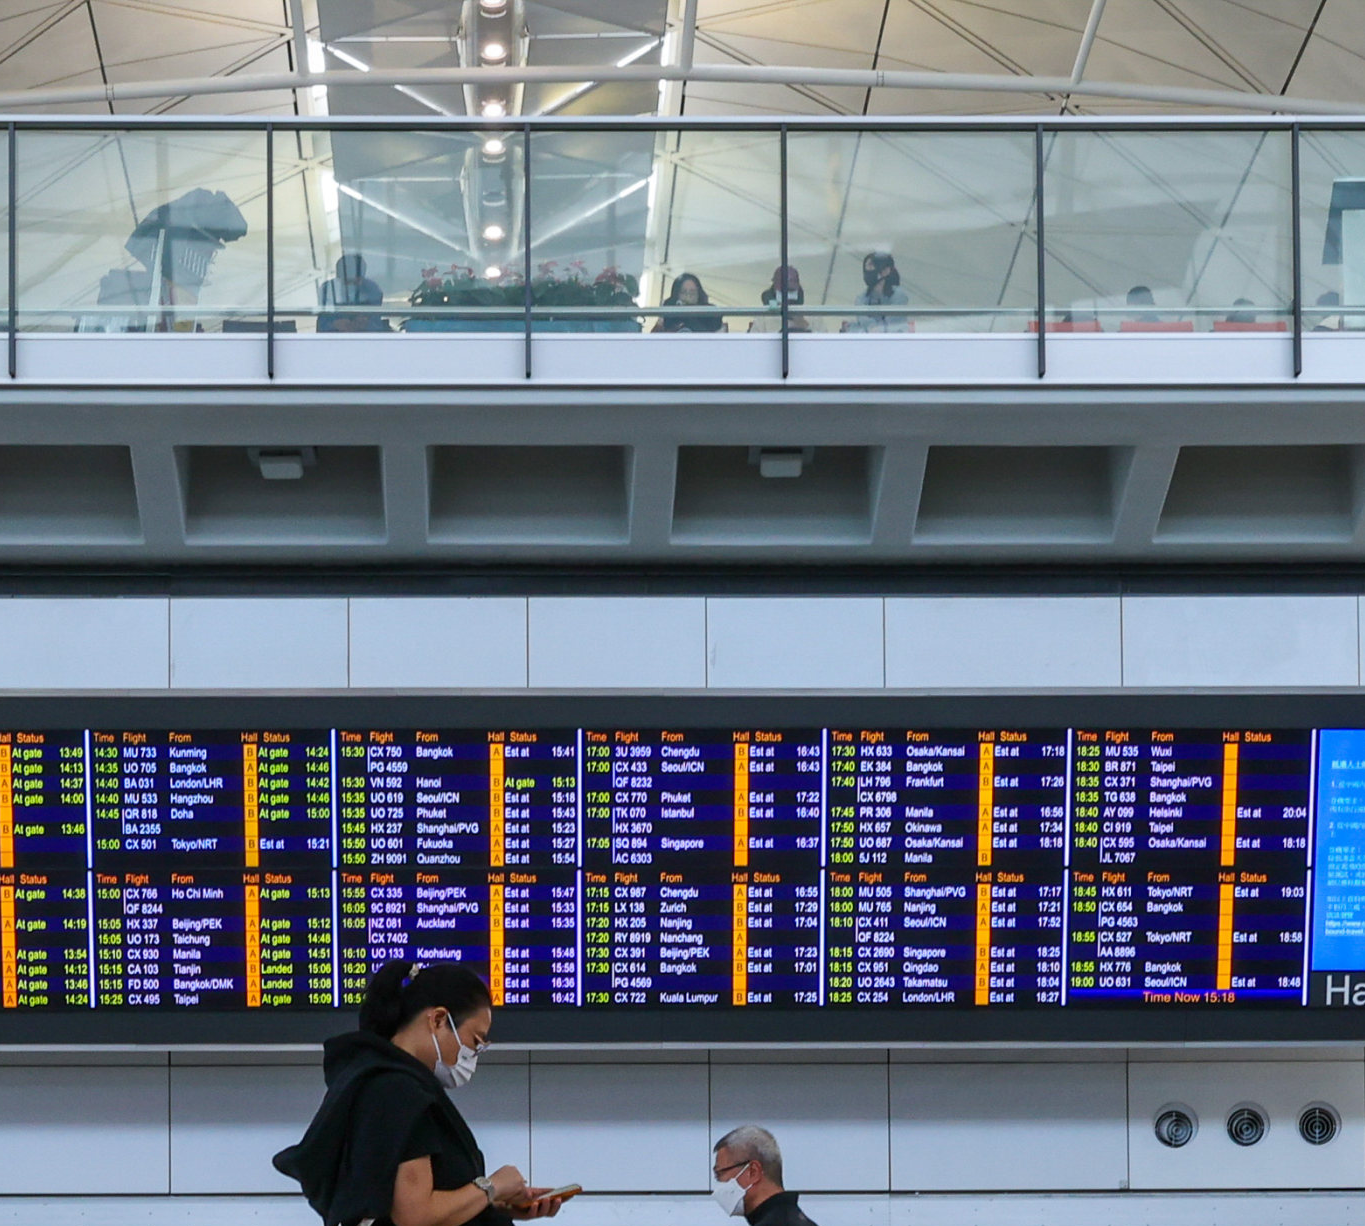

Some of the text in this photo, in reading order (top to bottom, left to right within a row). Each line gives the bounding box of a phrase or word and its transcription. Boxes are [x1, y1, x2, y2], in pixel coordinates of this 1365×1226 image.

[93, 731, 291, 746] Time Flight From Hall Status
[1076, 729, 1273, 745] Time Flight From Hall Status
[93, 746, 208, 761] 14:30 Kunming
[415, 745, 454, 760] Bangkok
[586, 745, 700, 760] 17:00 Chengdu
[906, 745, 966, 757] Osaka/Kansai
[1076, 744, 1173, 758] 18:25 Wuxi
[169, 761, 207, 776] Bangkok
[661, 760, 705, 773] Seoul/ICN
[831, 760, 944, 775] 17:40 Bangkok
[1150, 760, 1176, 775] Taipei
[94, 777, 224, 790] 14:40 London/LHR
[341, 776, 442, 789] 15:30 Hanoi
[905, 775, 945, 788] Frankfurt
[1149, 775, 1213, 790] Shanghai/PVG
[170, 792, 214, 807] Hangzhou
[416, 791, 460, 804] Seoul/ICN
[660, 791, 692, 804] Phuket
[1149, 790, 1187, 806] Bangkok
[170, 807, 194, 820] Doha
[416, 806, 447, 819] Phuket
[660, 806, 695, 819] Istanbul
[904, 805, 934, 818] Manila
[1074, 805, 1183, 819] 18:40 Helsinki
[416, 822, 479, 836] Shanghai/PVG
[904, 821, 943, 834] Okinawa
[1148, 821, 1174, 836] Taipei
[170, 837, 218, 852] Tokyo/NRT
[341, 837, 454, 850] 15:50 Fukuoka
[586, 836, 705, 851] 17:05 Singapore
[904, 836, 964, 849] Osaka/Kansai
[1147, 836, 1207, 849] Osaka/Kansai
[416, 852, 461, 865] Quanzhou
[904, 851, 933, 864] Manila
[584, 871, 782, 886] Time Flight From Hall Status
[171, 887, 224, 900] Ho Chi Minh
[342, 886, 467, 901] 15:55 Beijing/PEK
[659, 886, 699, 901] Chengdu
[830, 886, 967, 900] 18:00 Shanghai/PVG
[1072, 885, 1194, 900] 18:45 Tokyo/NRT
[416, 902, 479, 916] Shanghai/PVG
[659, 901, 688, 914] Zurich
[903, 901, 937, 916] Nanjing
[1146, 900, 1184, 915] Bangkok
[97, 917, 223, 932] 15:05 Beijing/PEK
[416, 917, 456, 929] Auckland
[585, 916, 693, 931] 17:20 Nanjing
[903, 916, 947, 928] Seoul/ICN
[172, 932, 211, 947] Taichung
[659, 931, 704, 946] Nanchang
[1145, 931, 1193, 945] Tokyo/NRT
[172, 948, 202, 960] Manila
[416, 947, 462, 961] Kaohsiung
[659, 946, 710, 961] Beijing/PEK
[903, 946, 947, 960] Singapore
[172, 962, 202, 977] Tianjin
[659, 961, 697, 976] Bangkok
[902, 960, 940, 976] Qingdao
[1144, 960, 1182, 975] Bangkok
[173, 978, 234, 992] Bangkok/DMK
[902, 975, 948, 988] Takamatsu
[1070, 975, 1188, 988] 19:00 Seoul/ICN
[99, 993, 199, 1007] 15:25 Taipei
[585, 991, 719, 1005] 17:30 Kuala Lumpur
[828, 991, 955, 1003] 18:25 London/LHR
[1142, 990, 1236, 1004] Time Now 15:18
